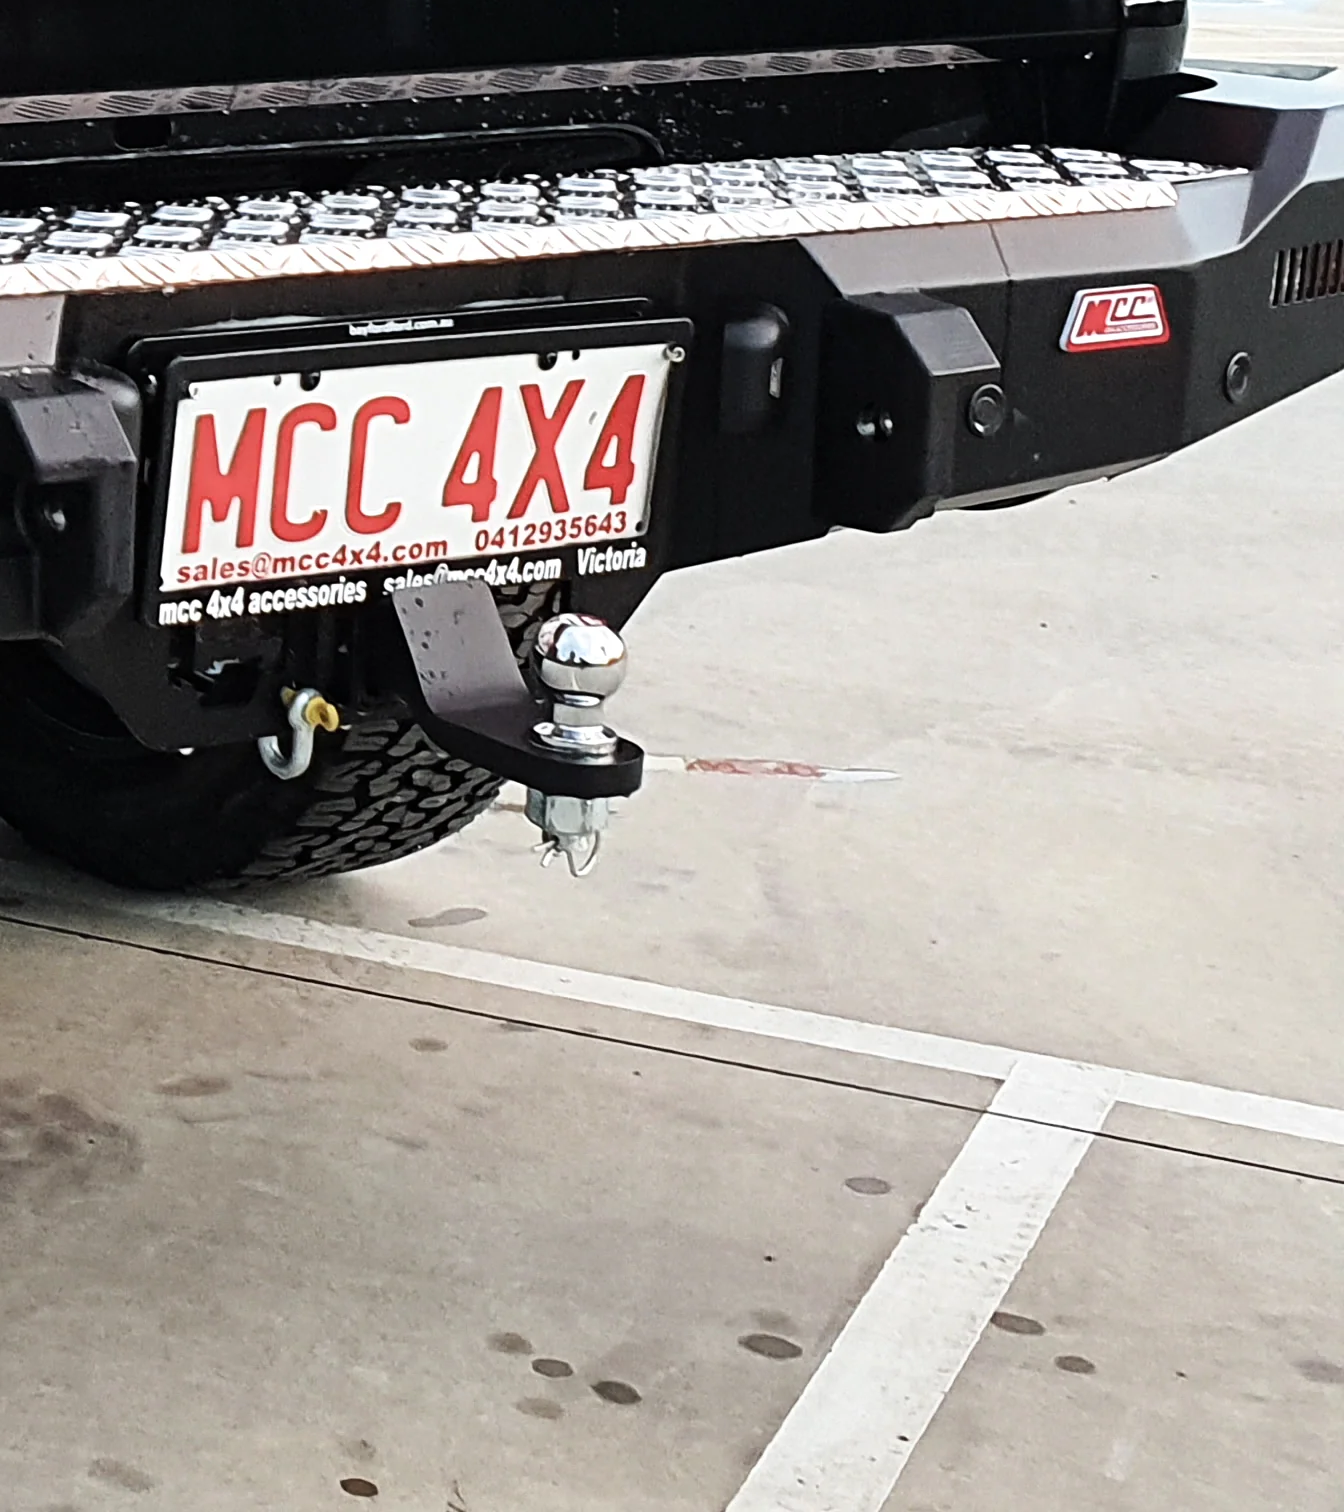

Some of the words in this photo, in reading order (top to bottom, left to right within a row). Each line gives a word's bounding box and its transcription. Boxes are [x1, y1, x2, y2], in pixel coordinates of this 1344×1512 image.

[1076, 296, 1156, 337] MCC
[180, 395, 411, 554] MCC
[442, 374, 646, 522] 4X4
[158, 598, 202, 626] mcc
[206, 586, 245, 619] 4x4
[248, 576, 368, 615] accessories
[577, 542, 647, 576] Victoria
[176, 540, 448, 584] sales@mcc4x4.com
[475, 511, 628, 552] 0412935643
